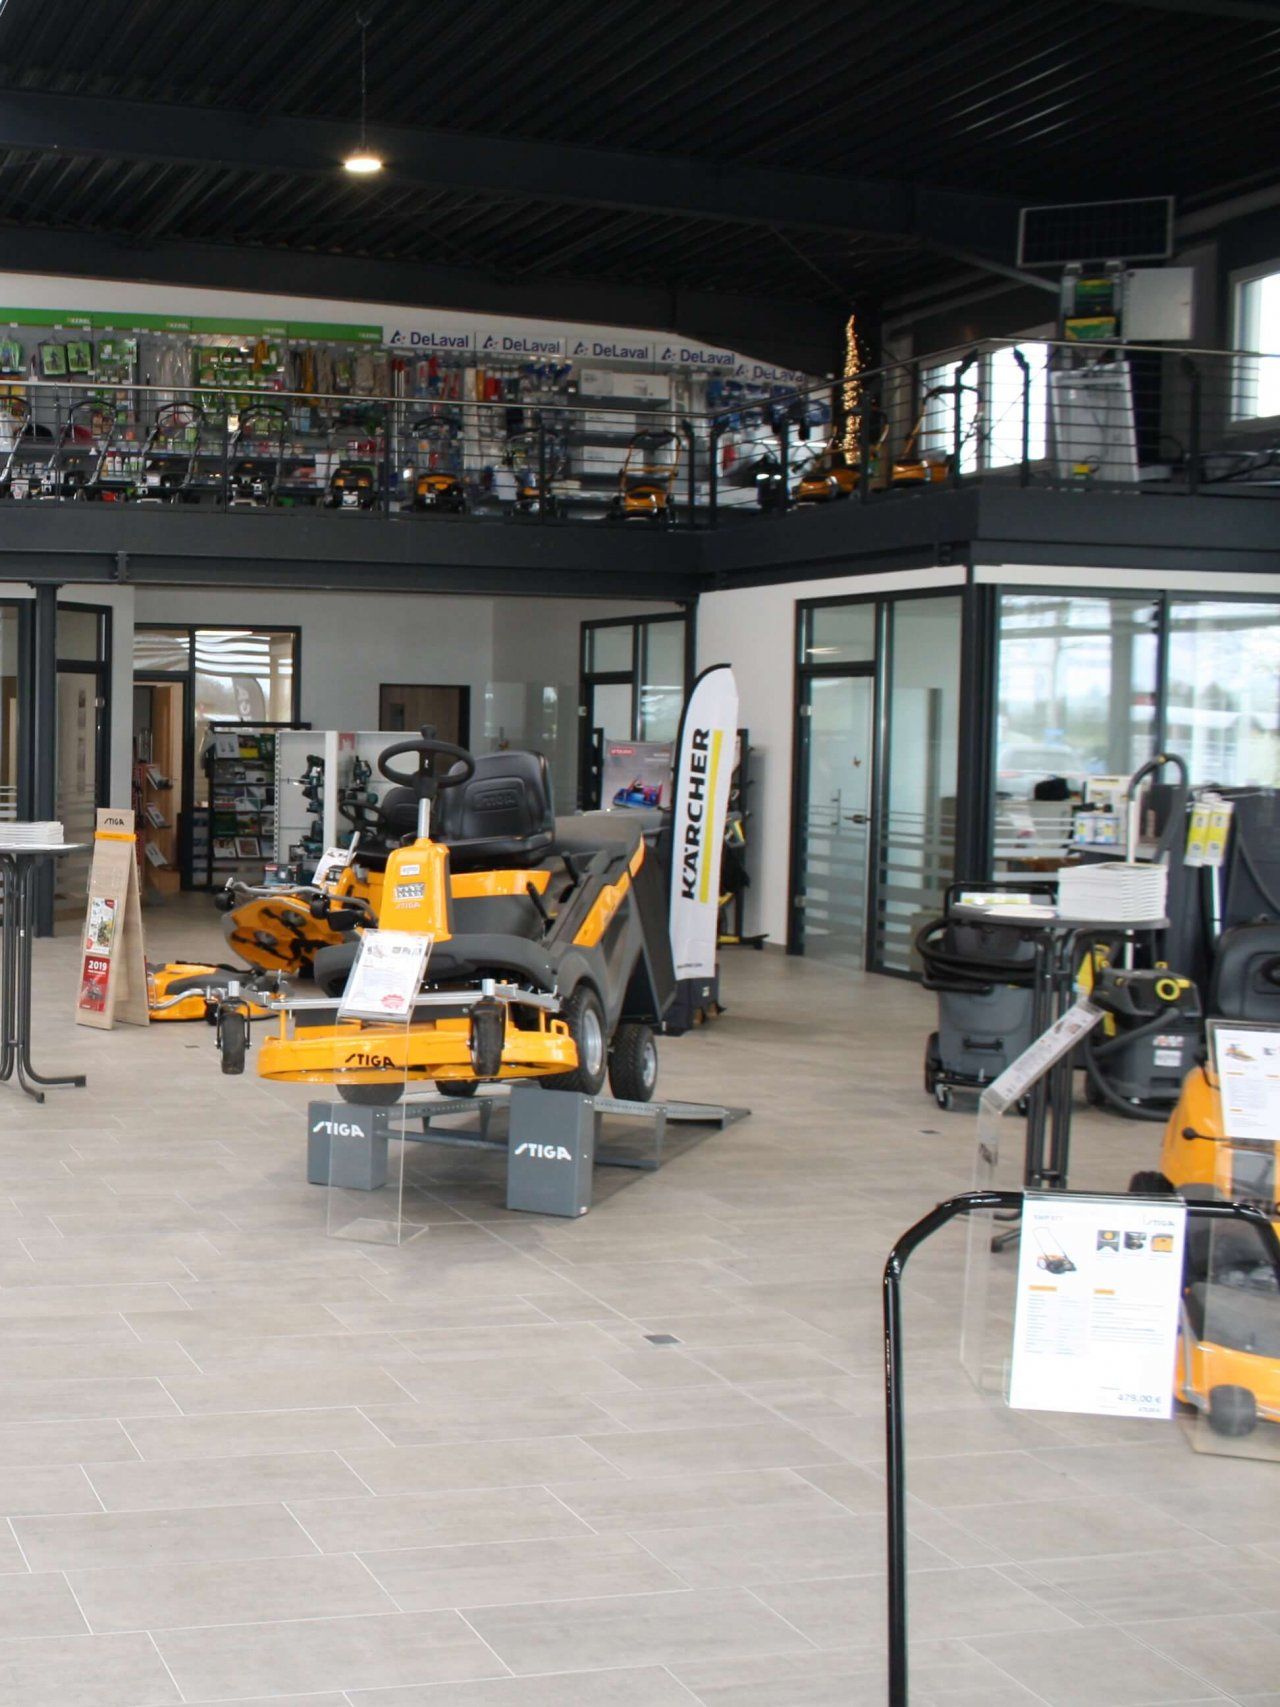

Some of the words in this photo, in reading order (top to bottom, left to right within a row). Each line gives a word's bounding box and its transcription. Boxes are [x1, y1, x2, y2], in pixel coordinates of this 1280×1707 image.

[410, 332, 469, 348] DeLaval
[502, 337, 560, 354] DeLaval
[593, 343, 648, 360] DeLaval
[680, 349, 736, 366] DeLaval
[104, 817, 125, 826] STIGA
[681, 728, 711, 900] KÄRCHER
[88, 960, 108, 971] 2019
[345, 1053, 396, 1068] STIGA
[312, 1121, 365, 1138] STIGA
[514, 1142, 572, 1161] STIGA
